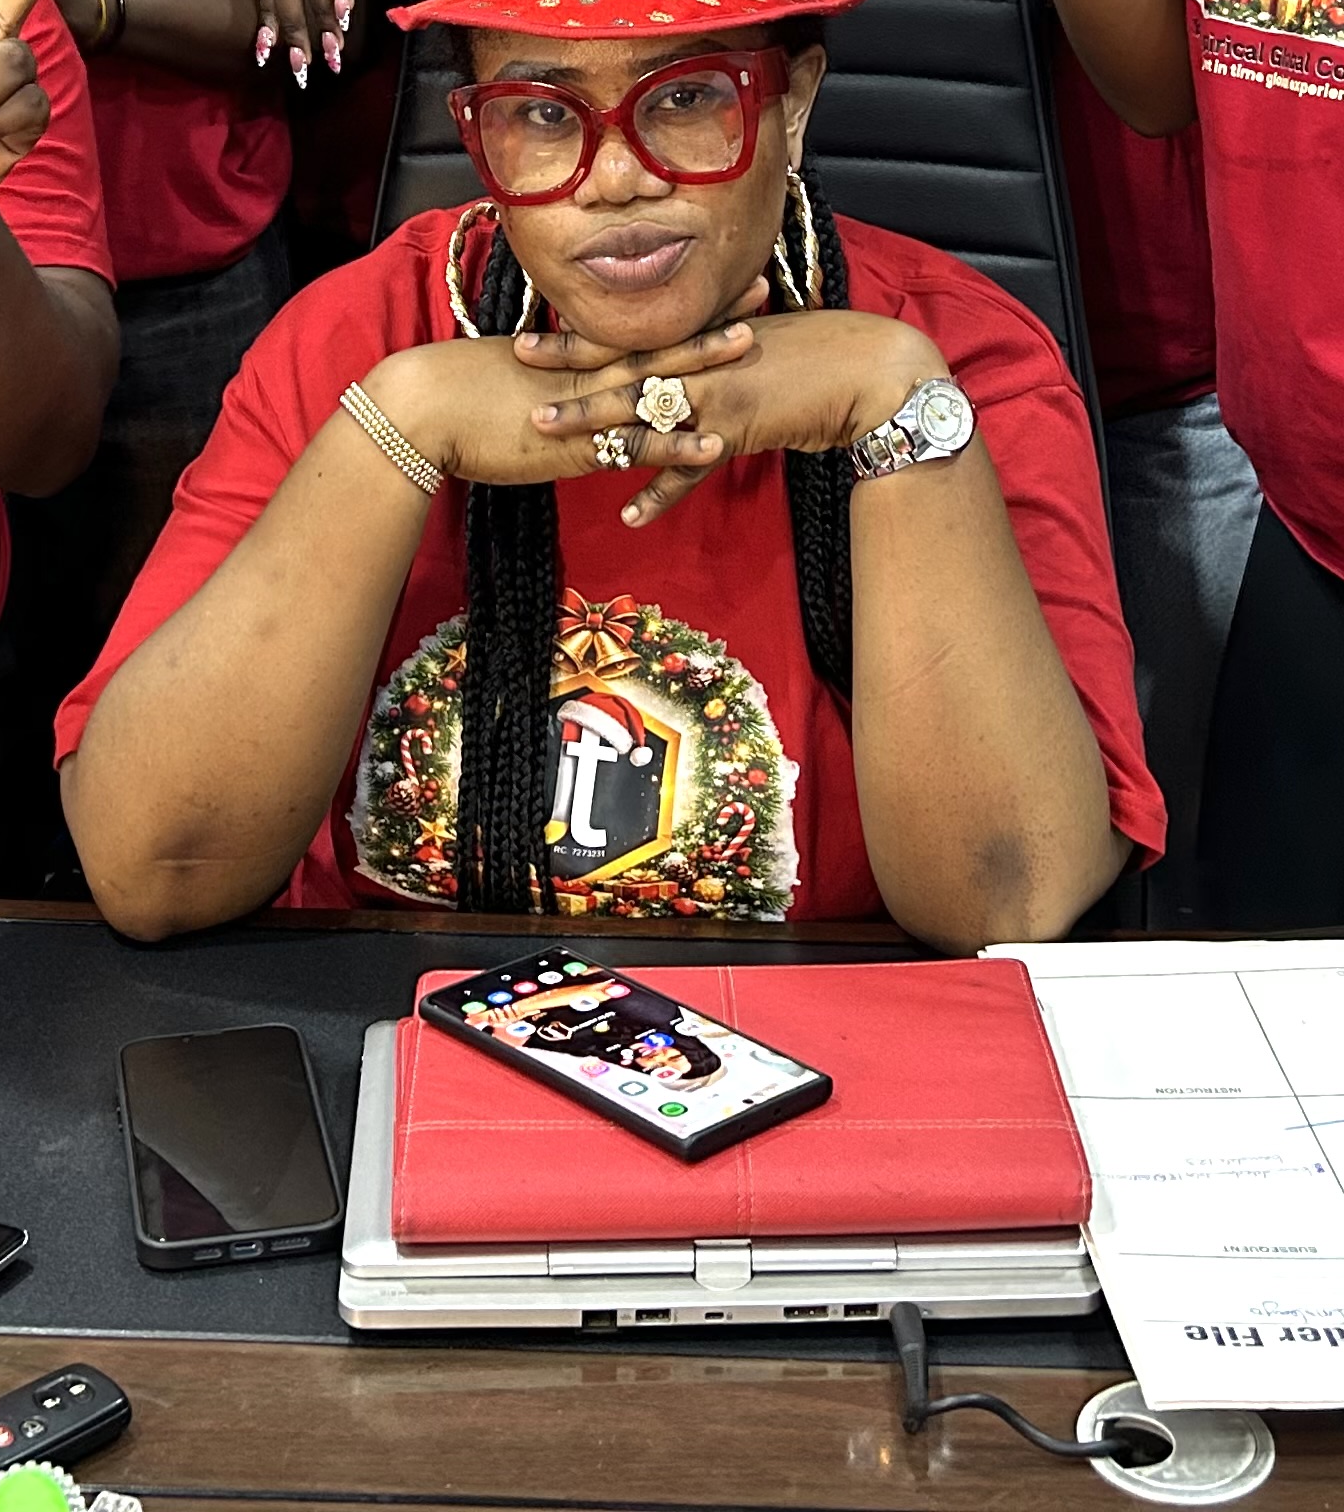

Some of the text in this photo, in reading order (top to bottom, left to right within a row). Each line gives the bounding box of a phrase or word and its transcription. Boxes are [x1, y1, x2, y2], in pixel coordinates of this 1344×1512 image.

[1229, 62, 1265, 84] time
[1154, 1086, 1243, 1096] INSTRUCTION
[1222, 1245, 1318, 1254] SUBSEQUENT
[1184, 1322, 1265, 1349] File
